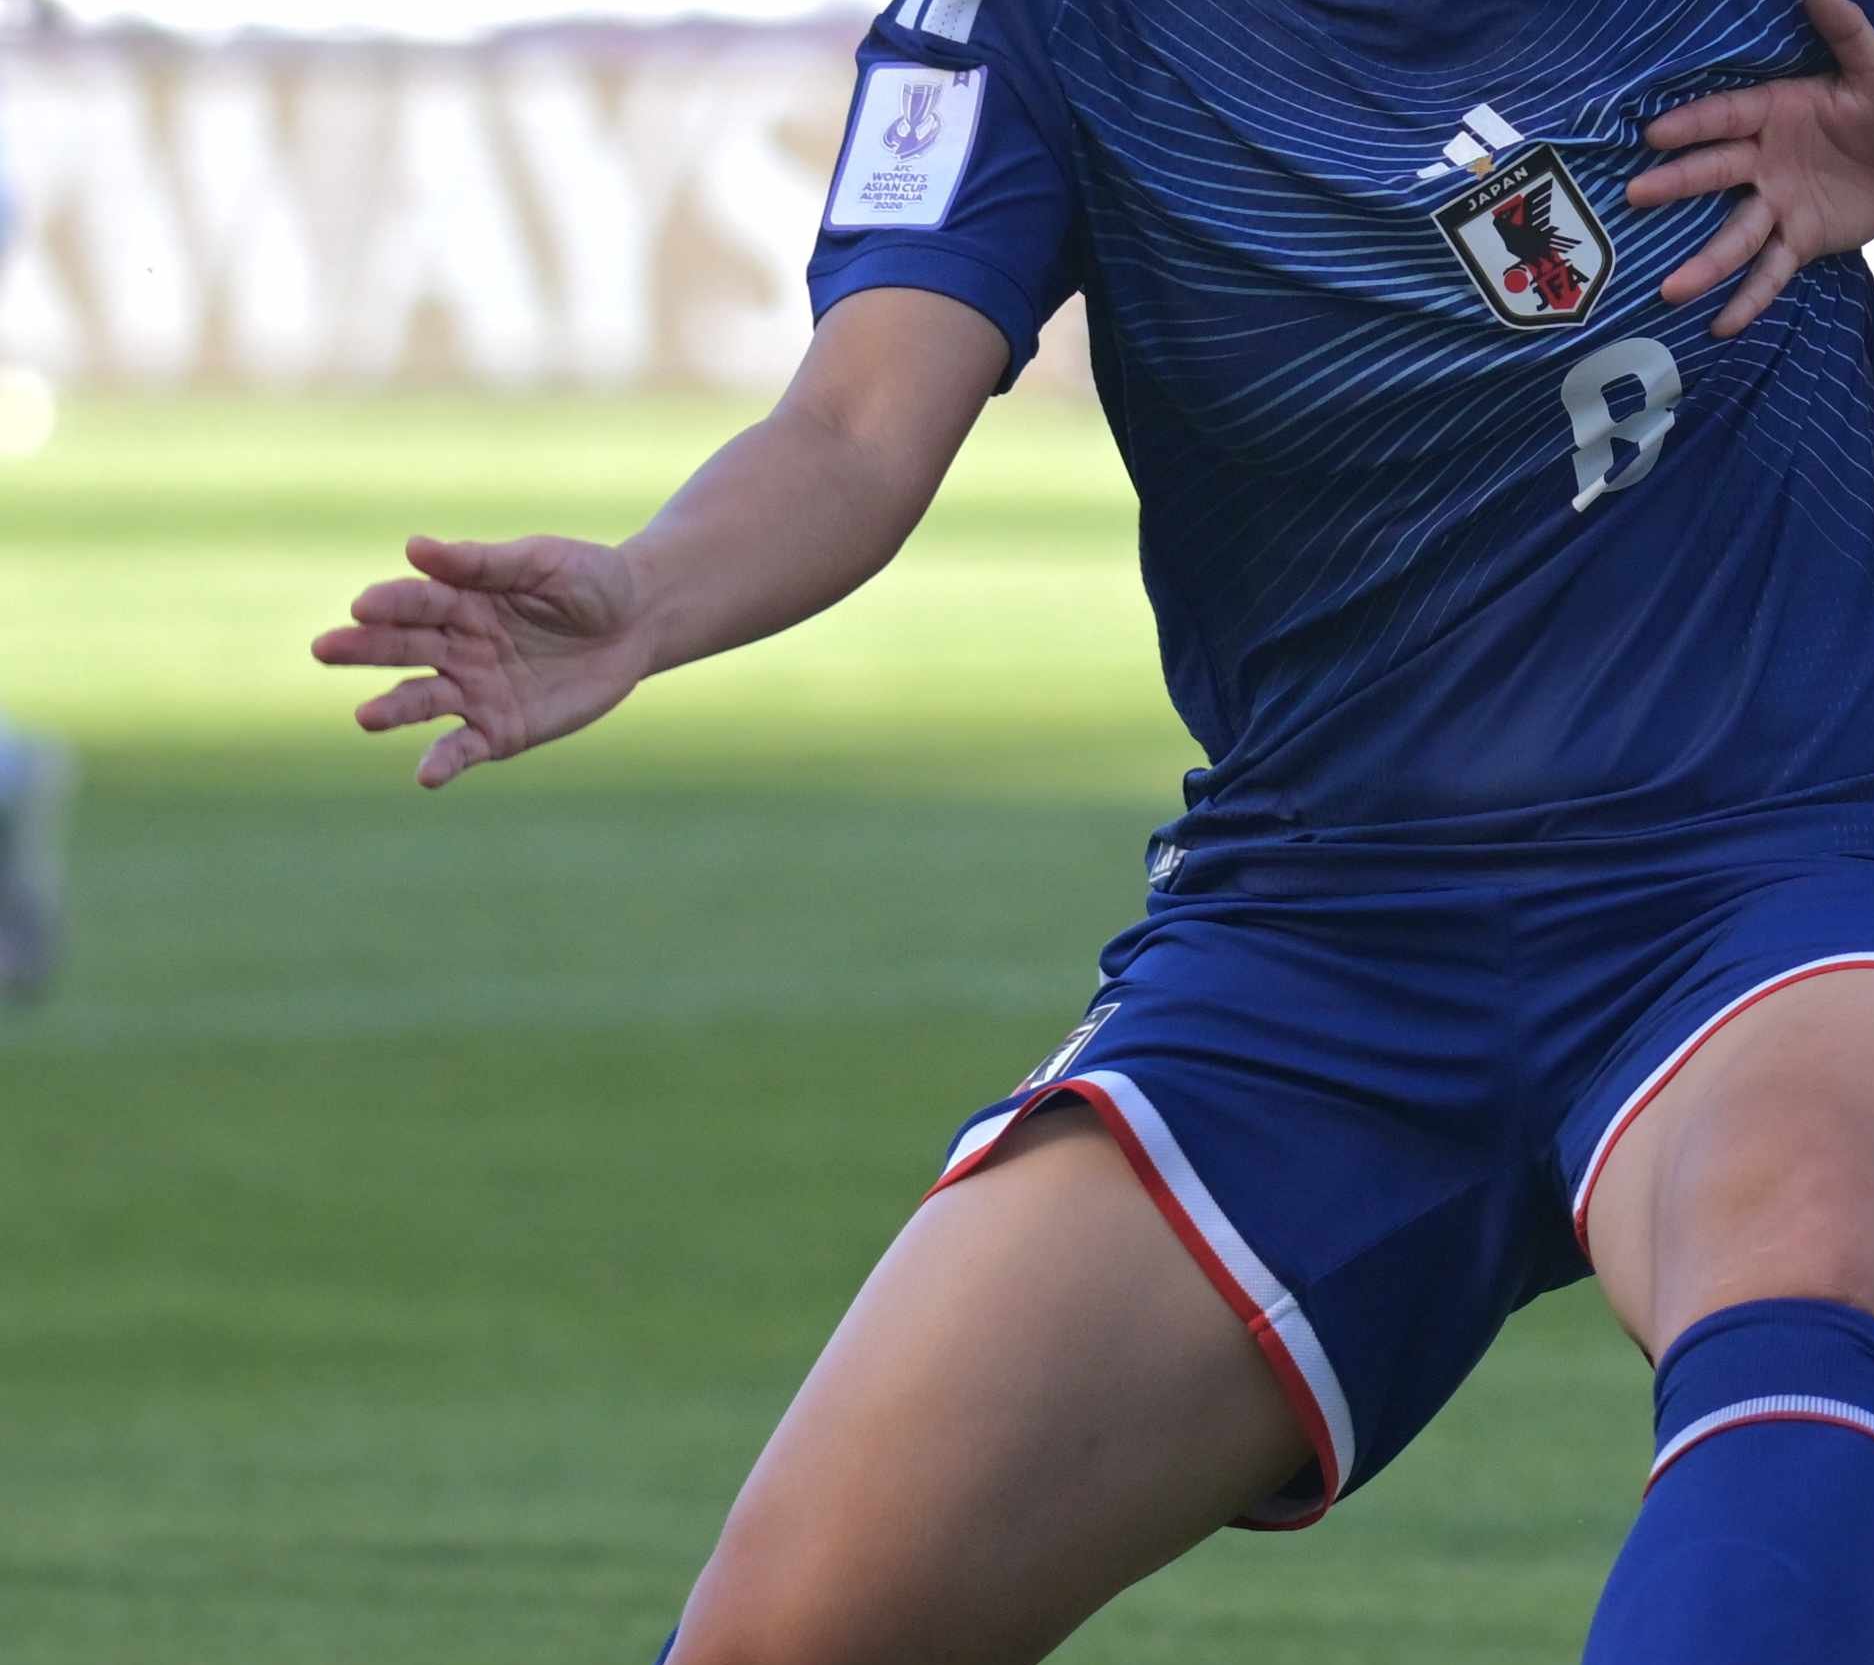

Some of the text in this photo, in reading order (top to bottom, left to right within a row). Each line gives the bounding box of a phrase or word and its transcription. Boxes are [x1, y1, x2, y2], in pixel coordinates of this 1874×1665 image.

[862, 182, 928, 193] ASIAN CUP
[872, 173, 928, 183] WOMEN'S
[1467, 166, 1529, 212] JAPAN
[860, 193, 922, 201] AUSTRALIA
[1533, 262, 1590, 311] JFA
[1560, 337, 1682, 513] 8
